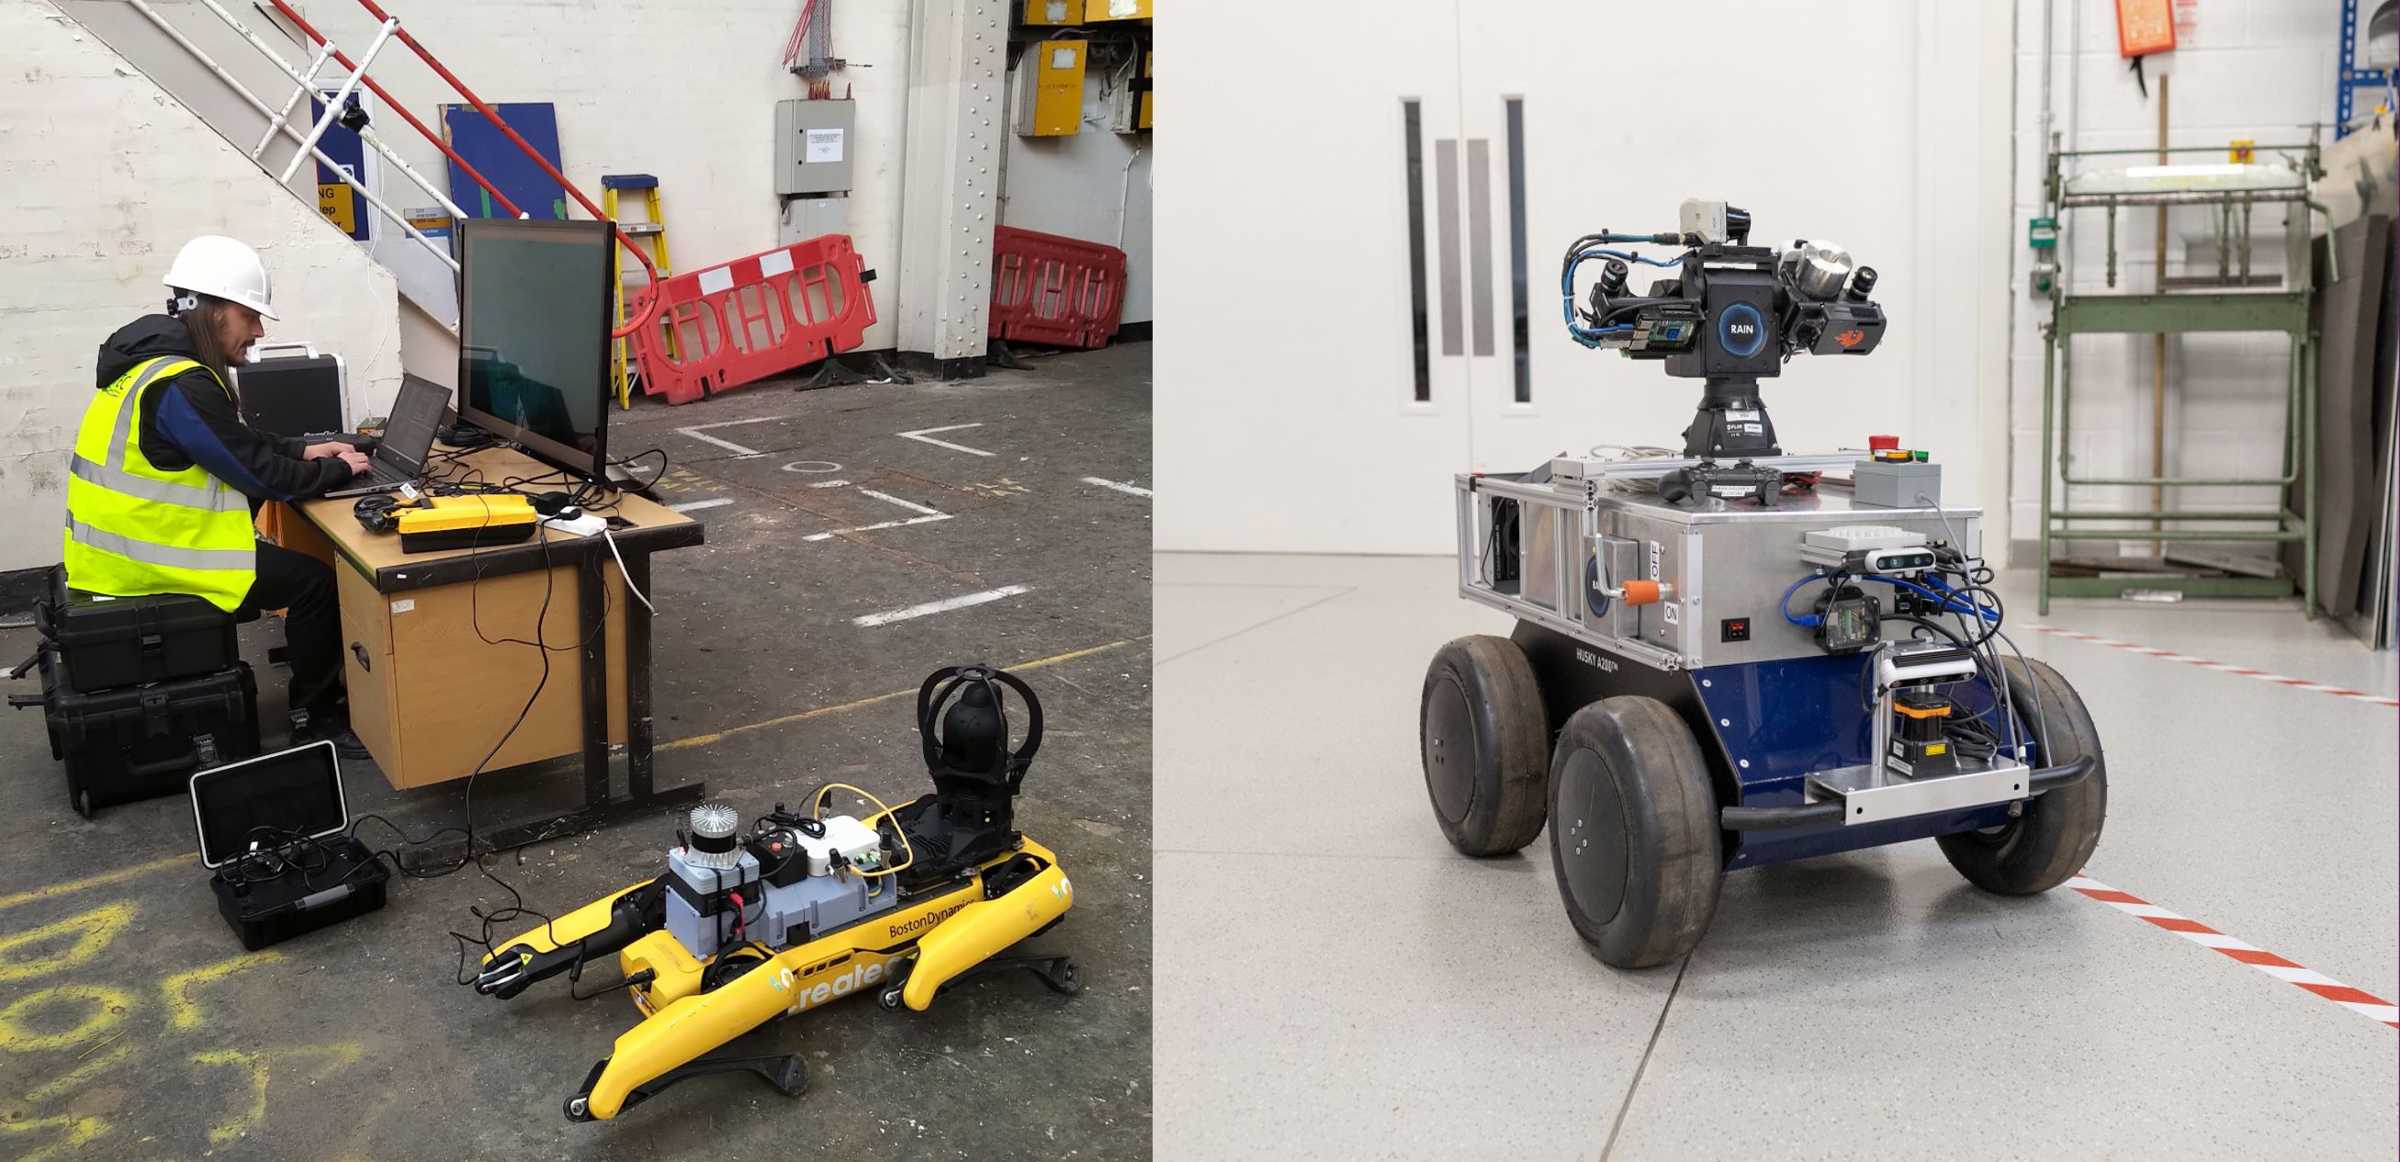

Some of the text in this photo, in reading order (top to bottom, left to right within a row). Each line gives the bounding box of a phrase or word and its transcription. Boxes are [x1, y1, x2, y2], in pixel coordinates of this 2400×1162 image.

[1730, 324, 1754, 334] RAIN
[1651, 543, 1659, 577] OFF
[1666, 605, 1677, 620] ON
[1576, 647, 1596, 666] HUSKY
